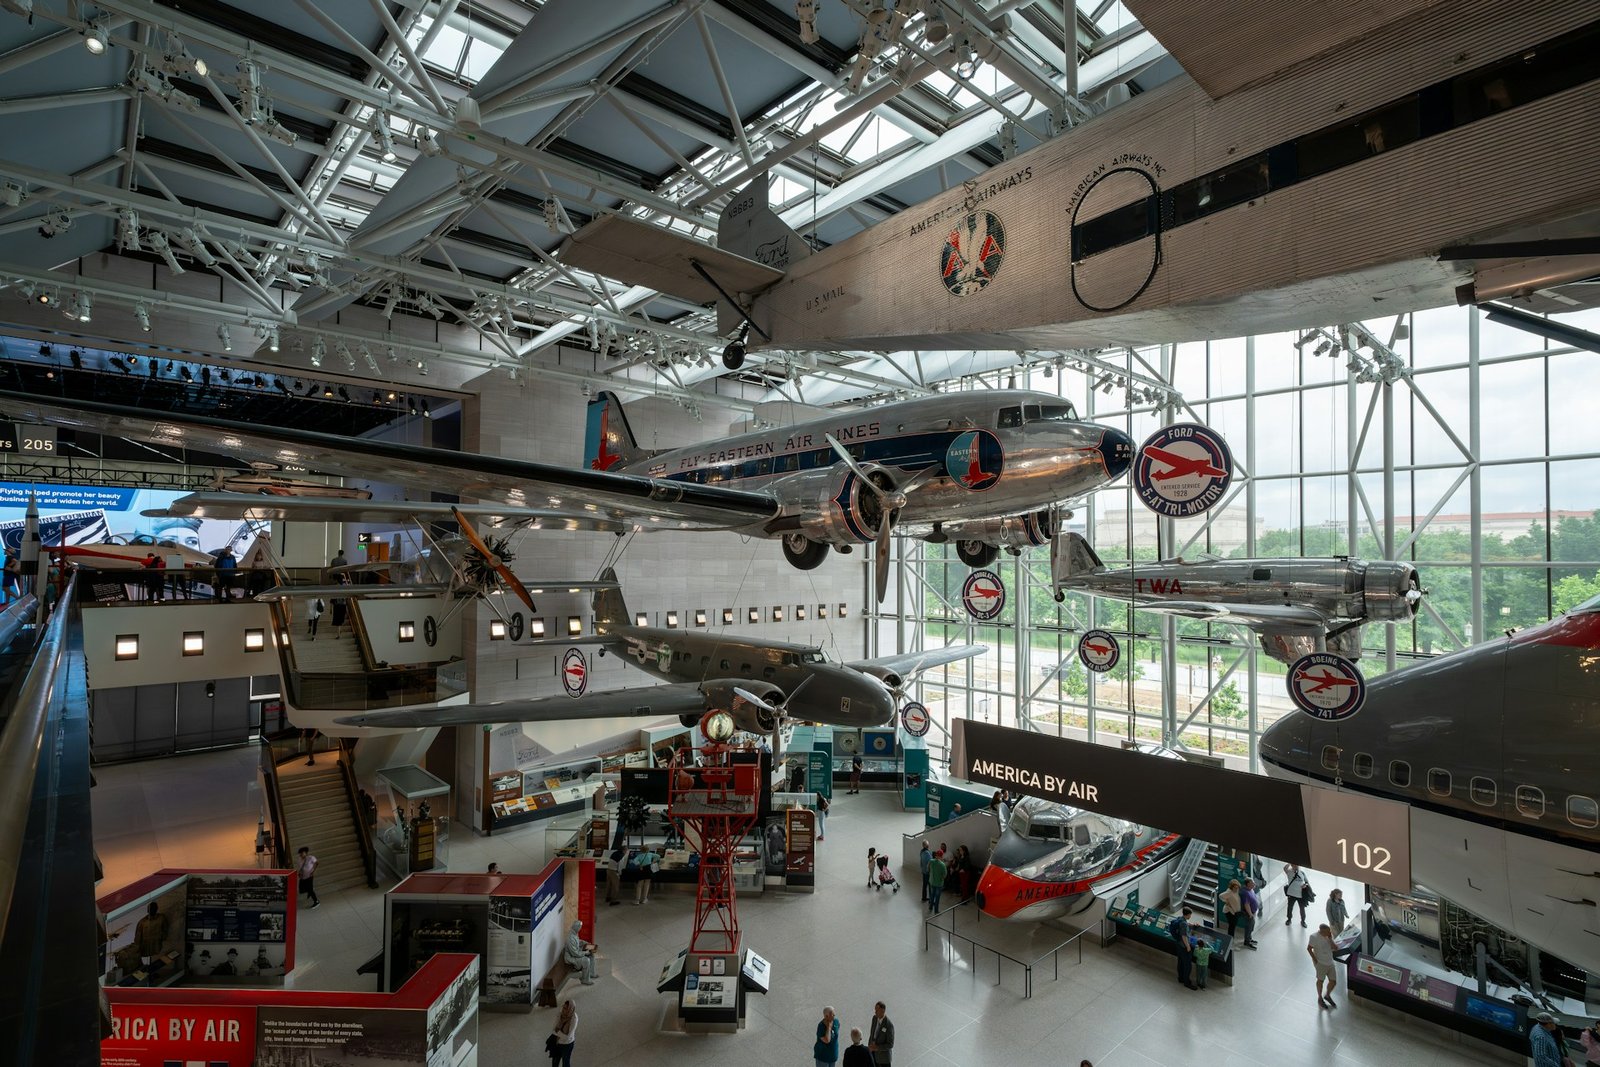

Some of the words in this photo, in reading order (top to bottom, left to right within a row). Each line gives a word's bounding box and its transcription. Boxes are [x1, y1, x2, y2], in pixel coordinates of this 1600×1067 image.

[974, 166, 1033, 205] AIRWAYS
[1065, 163, 1106, 214] AMERICAN
[1112, 153, 1153, 167] AIRWAYS
[728, 197, 754, 218] N9683
[755, 235, 789, 264] Ford
[770, 256, 789, 268] OTOR
[823, 285, 845, 301] MAIL
[1168, 427, 1193, 439] FORD
[23, 438, 53, 451] 205
[784, 434, 813, 450] AIR
[52, 490, 82, 498] promote
[1142, 487, 1164, 509] 5-AT
[1163, 484, 1223, 516] TRI-MOTOR
[60, 510, 104, 522] COCHRAN
[974, 571, 993, 579] DOUGLAS
[1135, 578, 1183, 594] TWA
[976, 611, 990, 619] DC-3
[1311, 656, 1337, 666] BOEING
[1317, 708, 1332, 719] 747
[972, 759, 1042, 789] AMERICA
[1044, 774, 1066, 794] BY
[1068, 781, 1099, 803] AIR
[1336, 838, 1392, 876] 102
[1015, 882, 1077, 901] AMERICAN
[168, 1018, 196, 1041] BY
[203, 1019, 240, 1042] AIR
